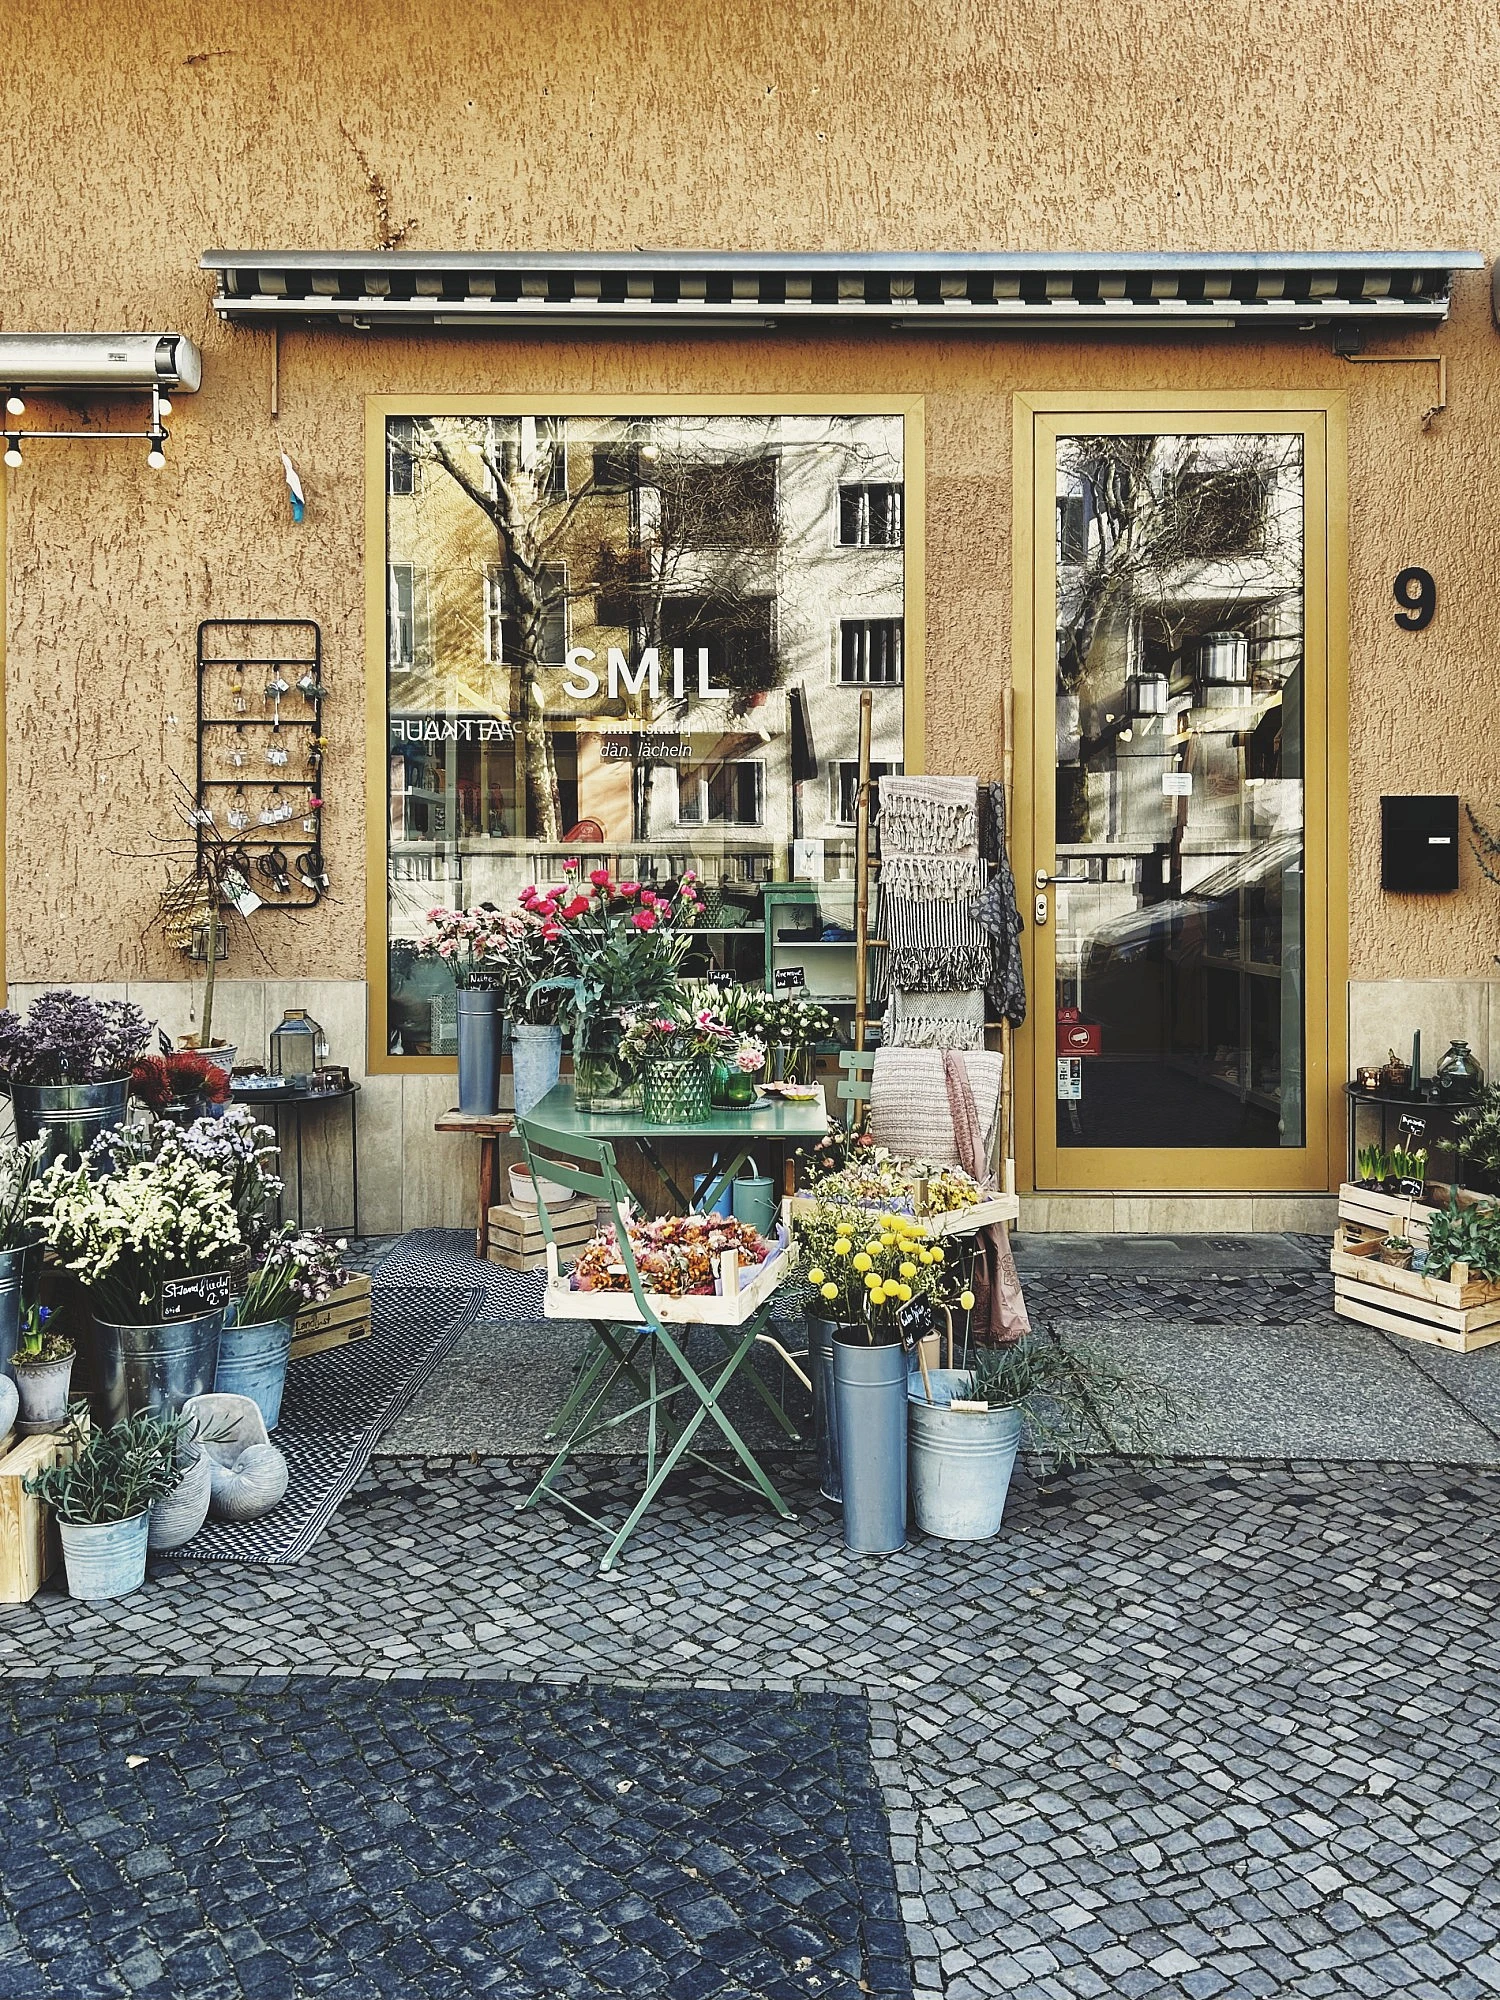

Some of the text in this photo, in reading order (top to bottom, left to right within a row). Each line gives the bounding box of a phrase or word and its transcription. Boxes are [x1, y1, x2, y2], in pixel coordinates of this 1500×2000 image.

[1392, 566, 1437, 631] 9
[562, 646, 730, 699] SMIL
[600, 741, 692, 757] dän. lächeln
